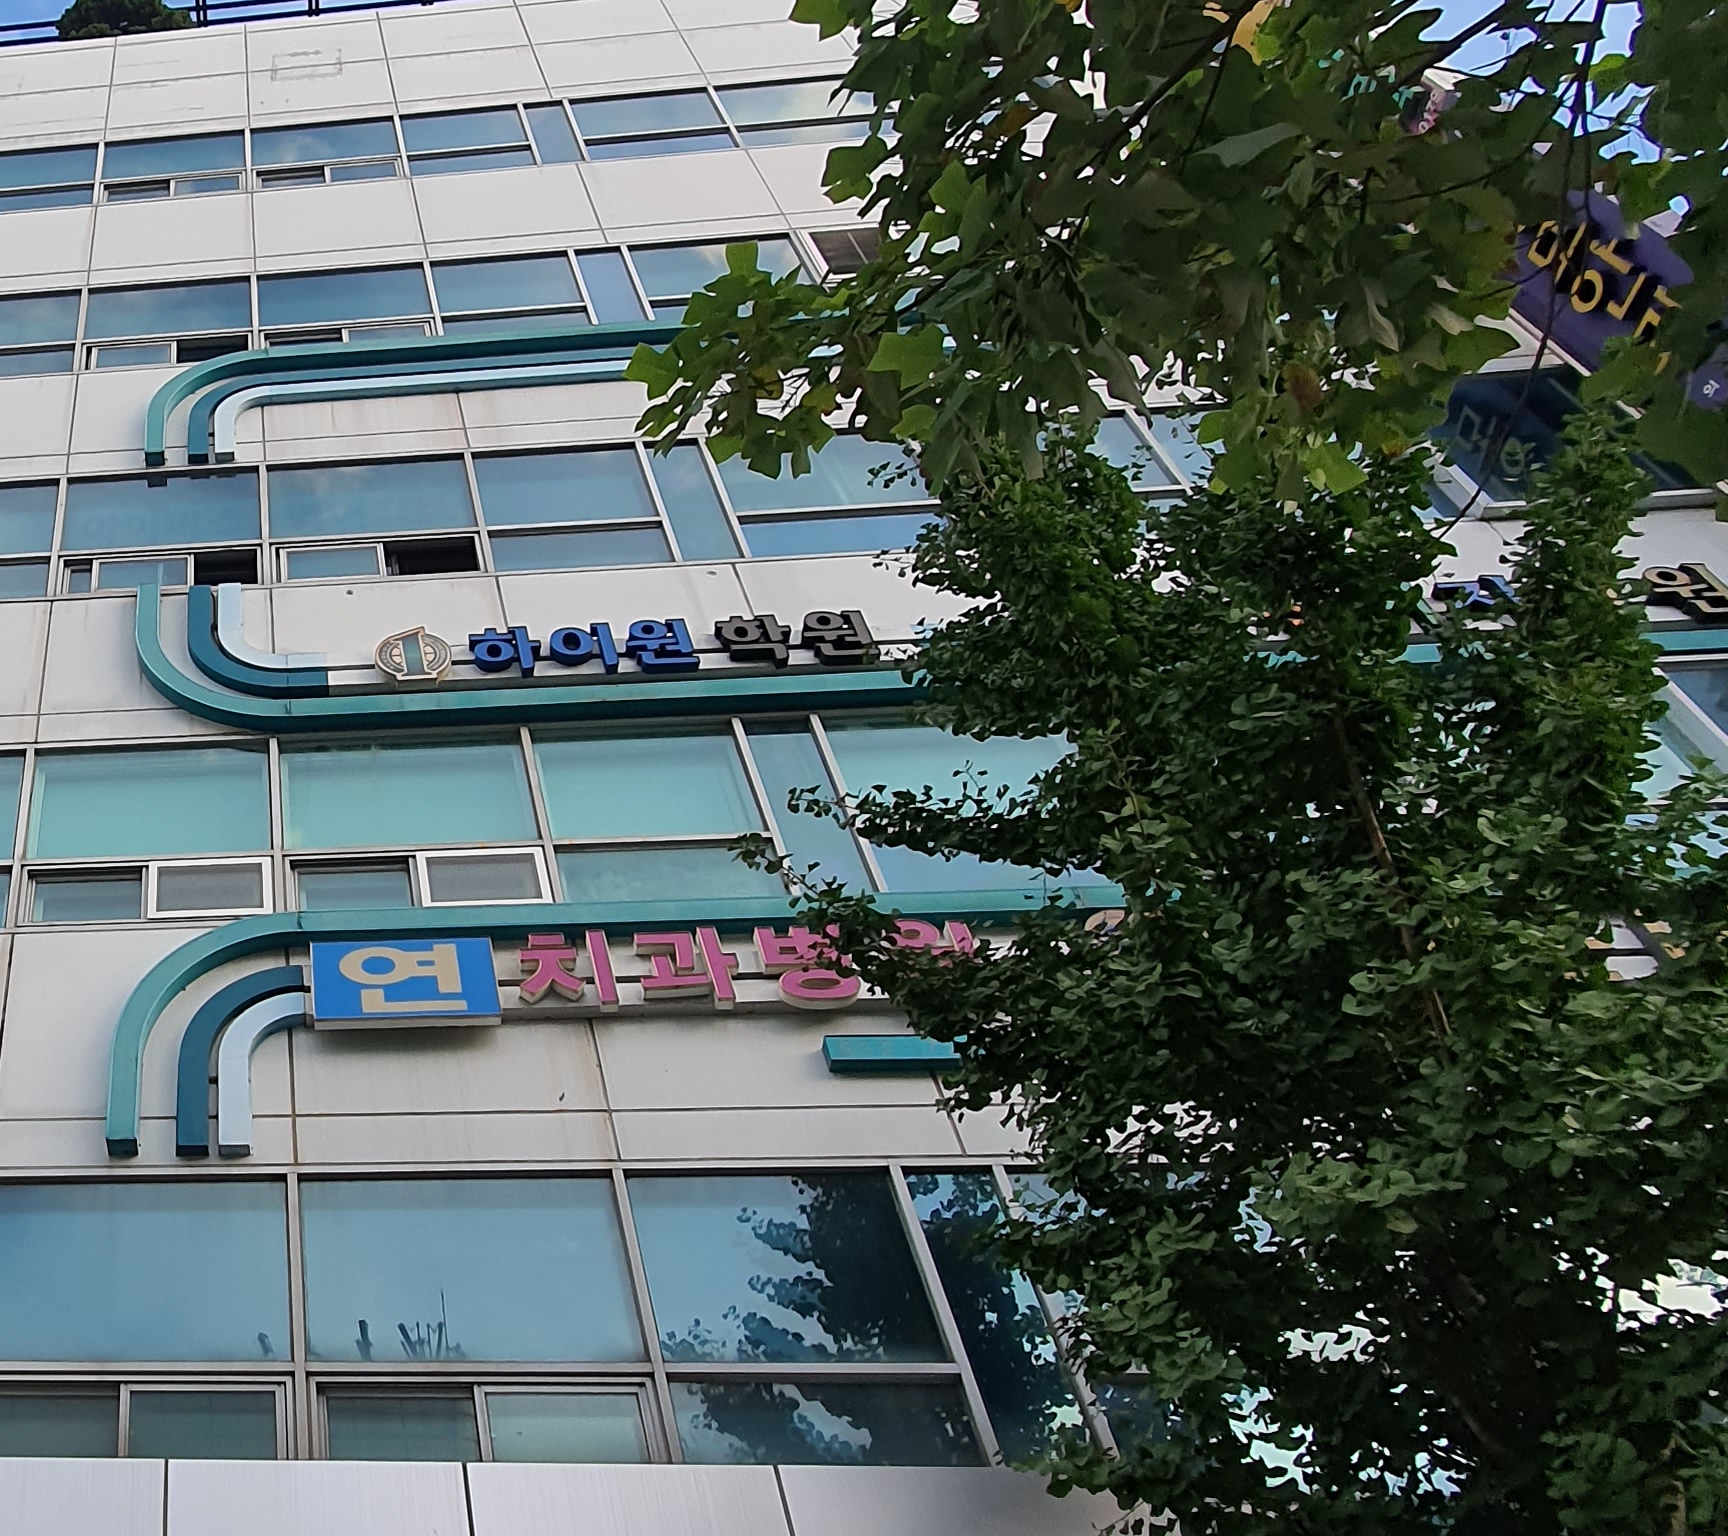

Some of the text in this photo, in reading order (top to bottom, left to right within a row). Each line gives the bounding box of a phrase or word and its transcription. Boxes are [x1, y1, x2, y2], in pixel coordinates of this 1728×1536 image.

[468, 609, 880, 673] 하이원 학원
[338, 942, 468, 1014] 연
